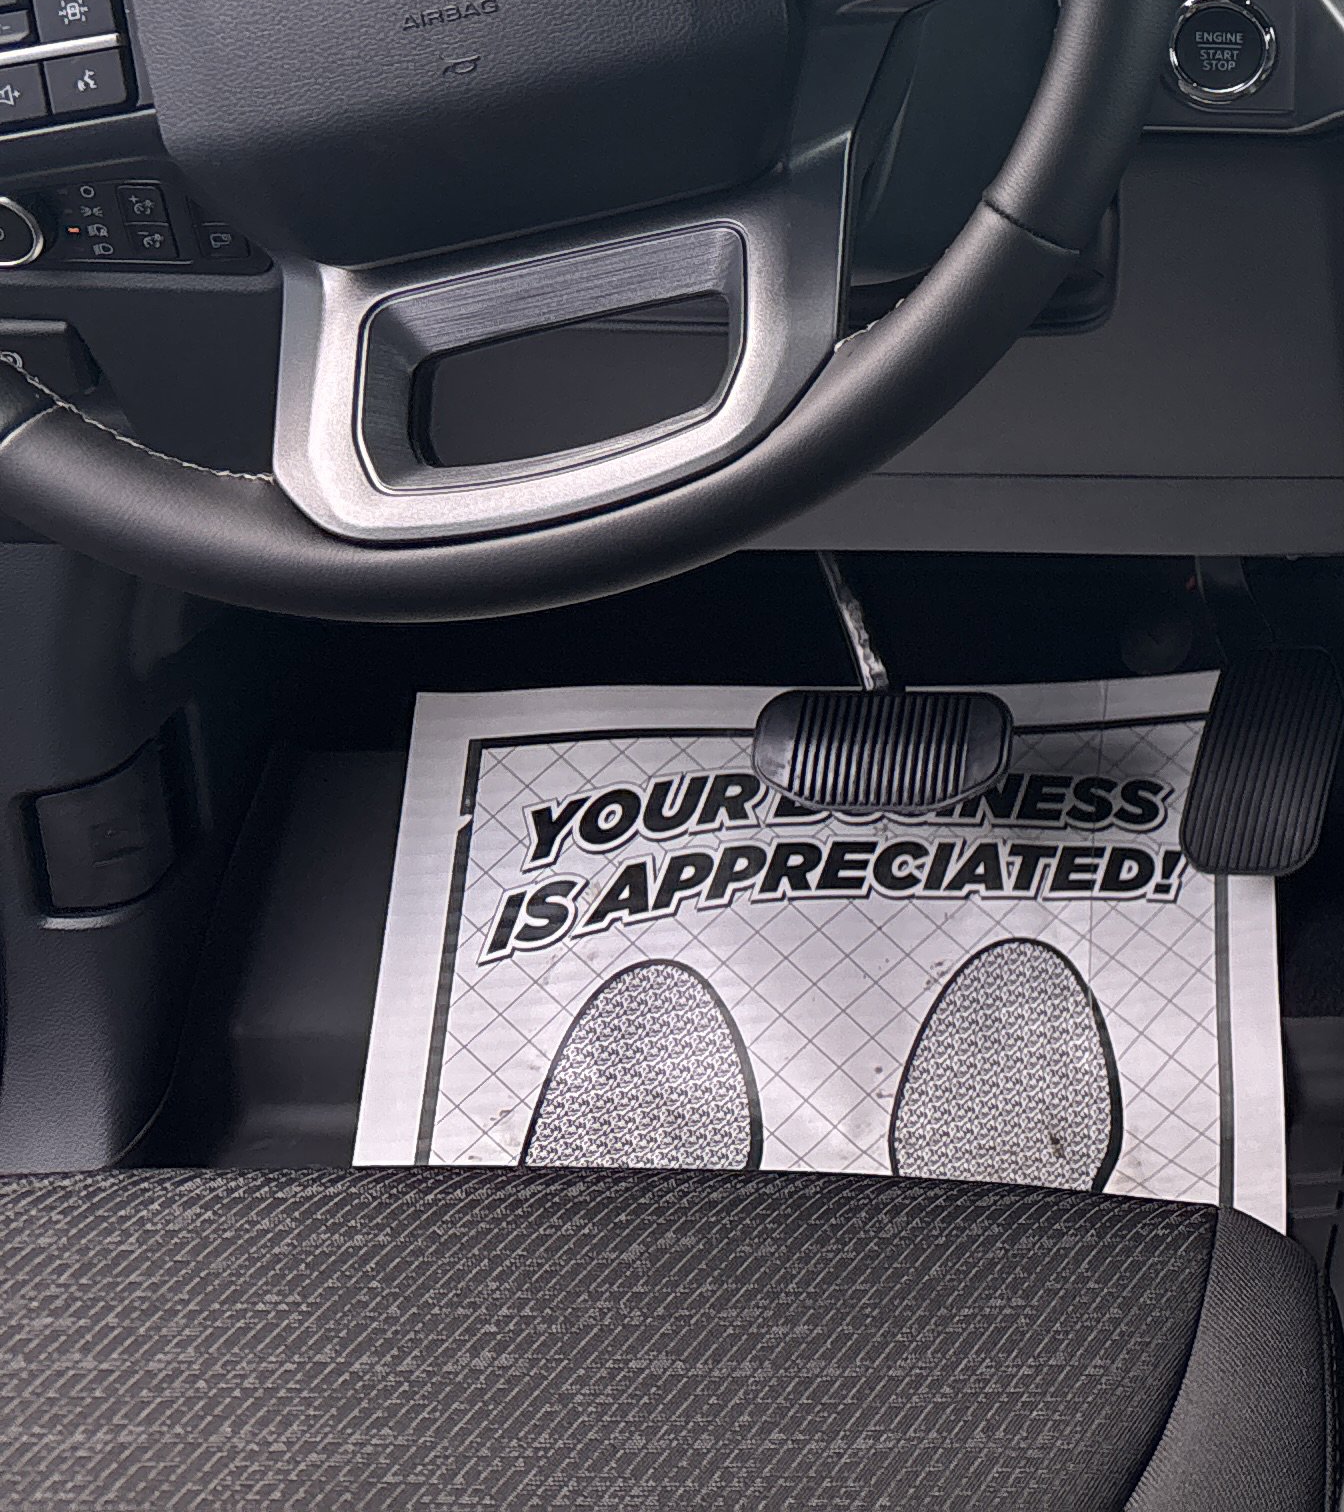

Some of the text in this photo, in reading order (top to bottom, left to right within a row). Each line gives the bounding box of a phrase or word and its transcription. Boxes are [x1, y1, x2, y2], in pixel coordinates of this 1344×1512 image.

[1195, 31, 1243, 43] ENGINE
[1200, 49, 1239, 60] START
[1203, 60, 1236, 71] STOP
[526, 772, 1174, 866] YOUR NESS
[487, 840, 1186, 954] IS APPRECIATED!
